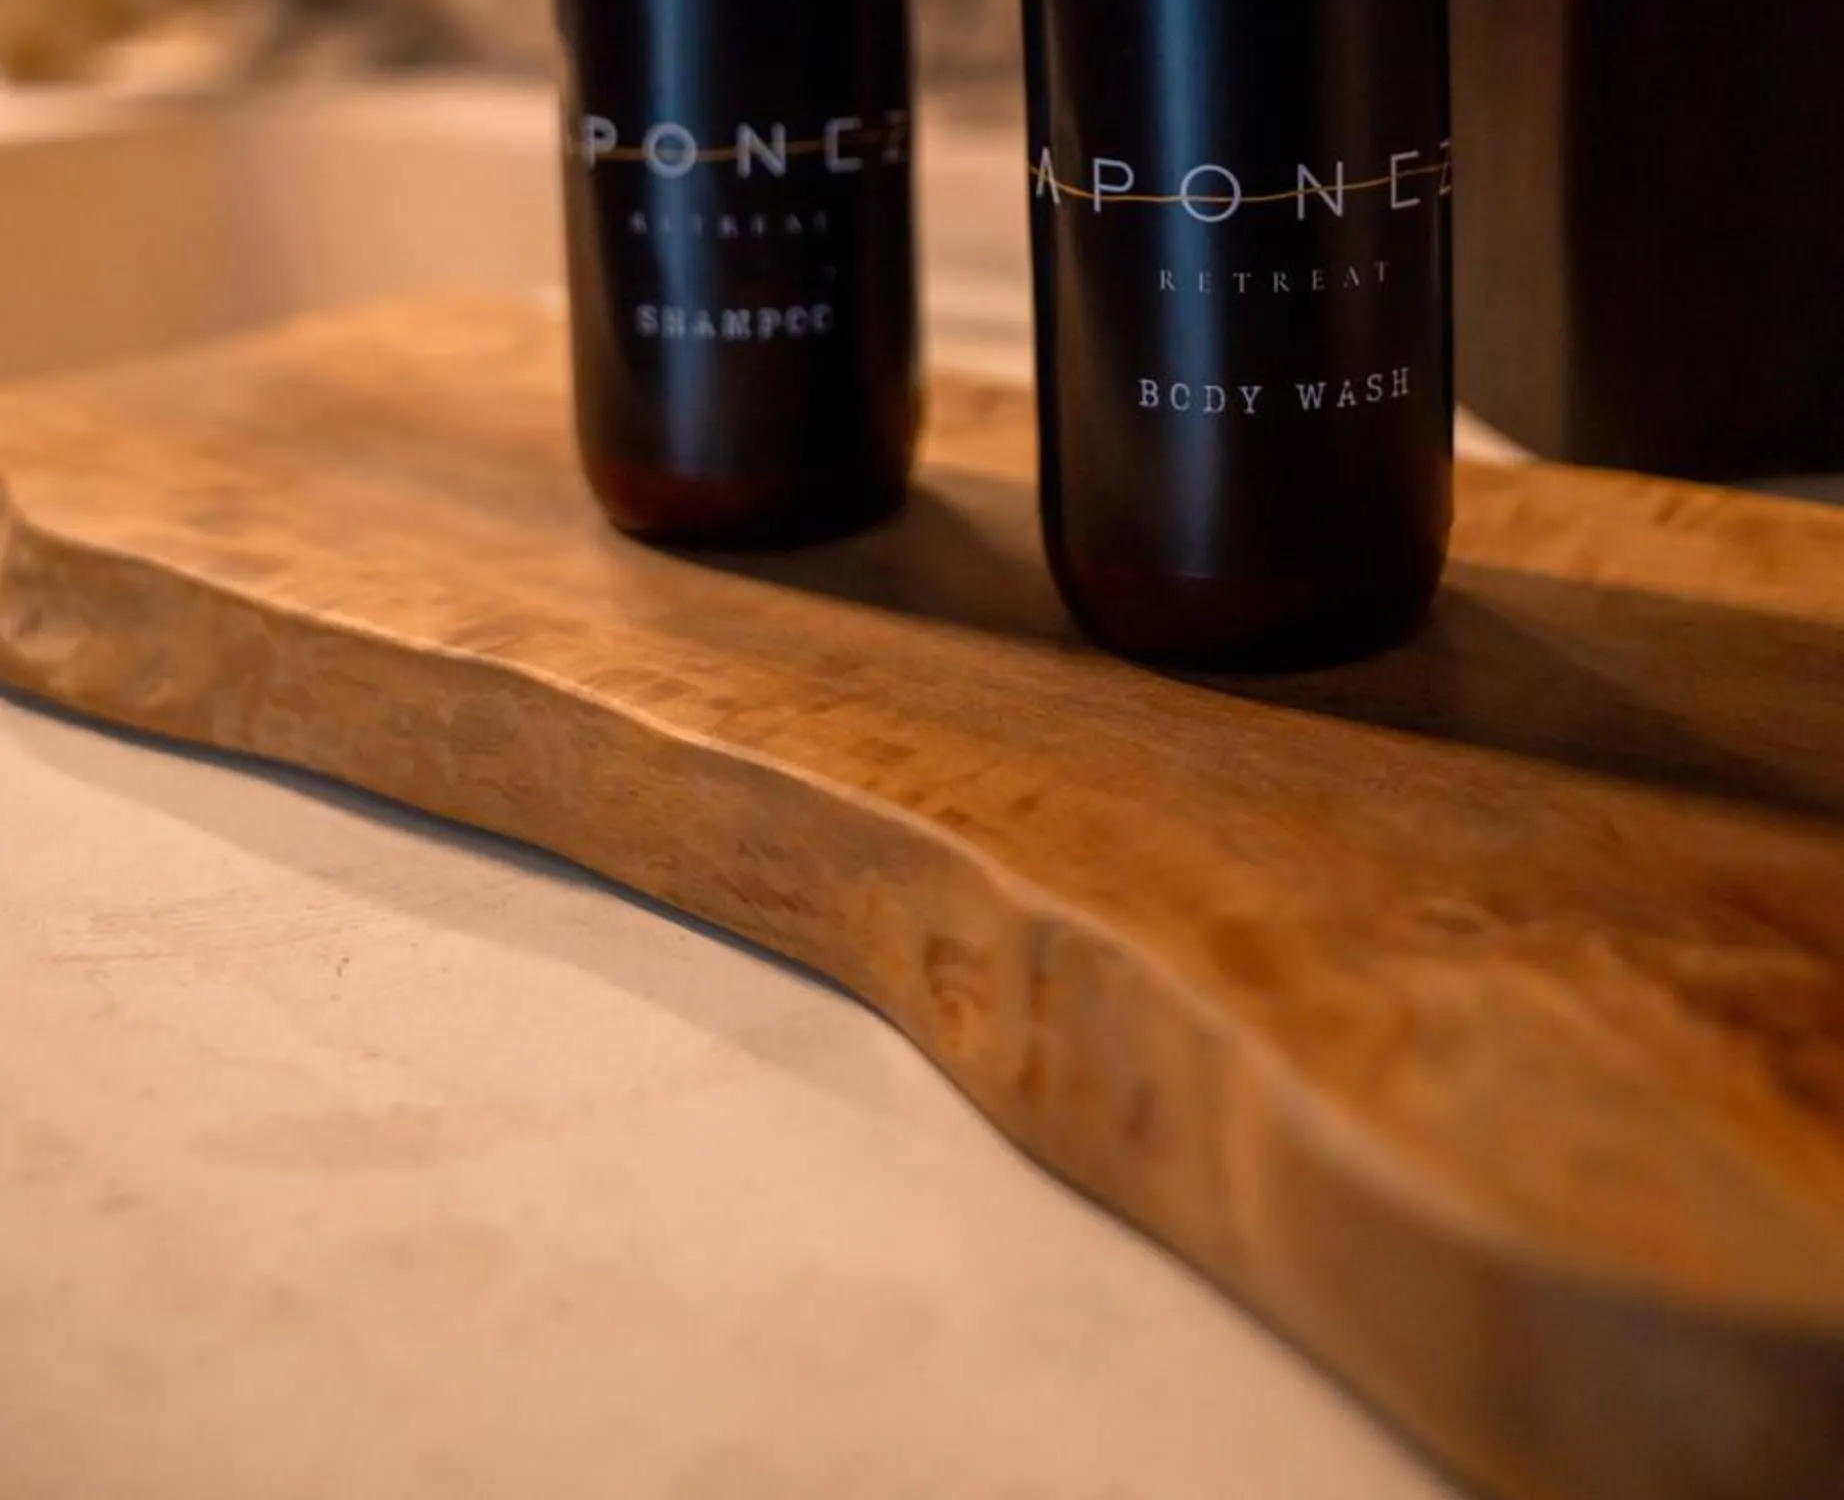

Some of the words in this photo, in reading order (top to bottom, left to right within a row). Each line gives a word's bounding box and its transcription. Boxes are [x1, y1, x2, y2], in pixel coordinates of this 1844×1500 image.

[1159, 261, 1390, 294] RETREAT
[1139, 379, 1262, 415] BODY
[1297, 367, 1409, 411] WASH
